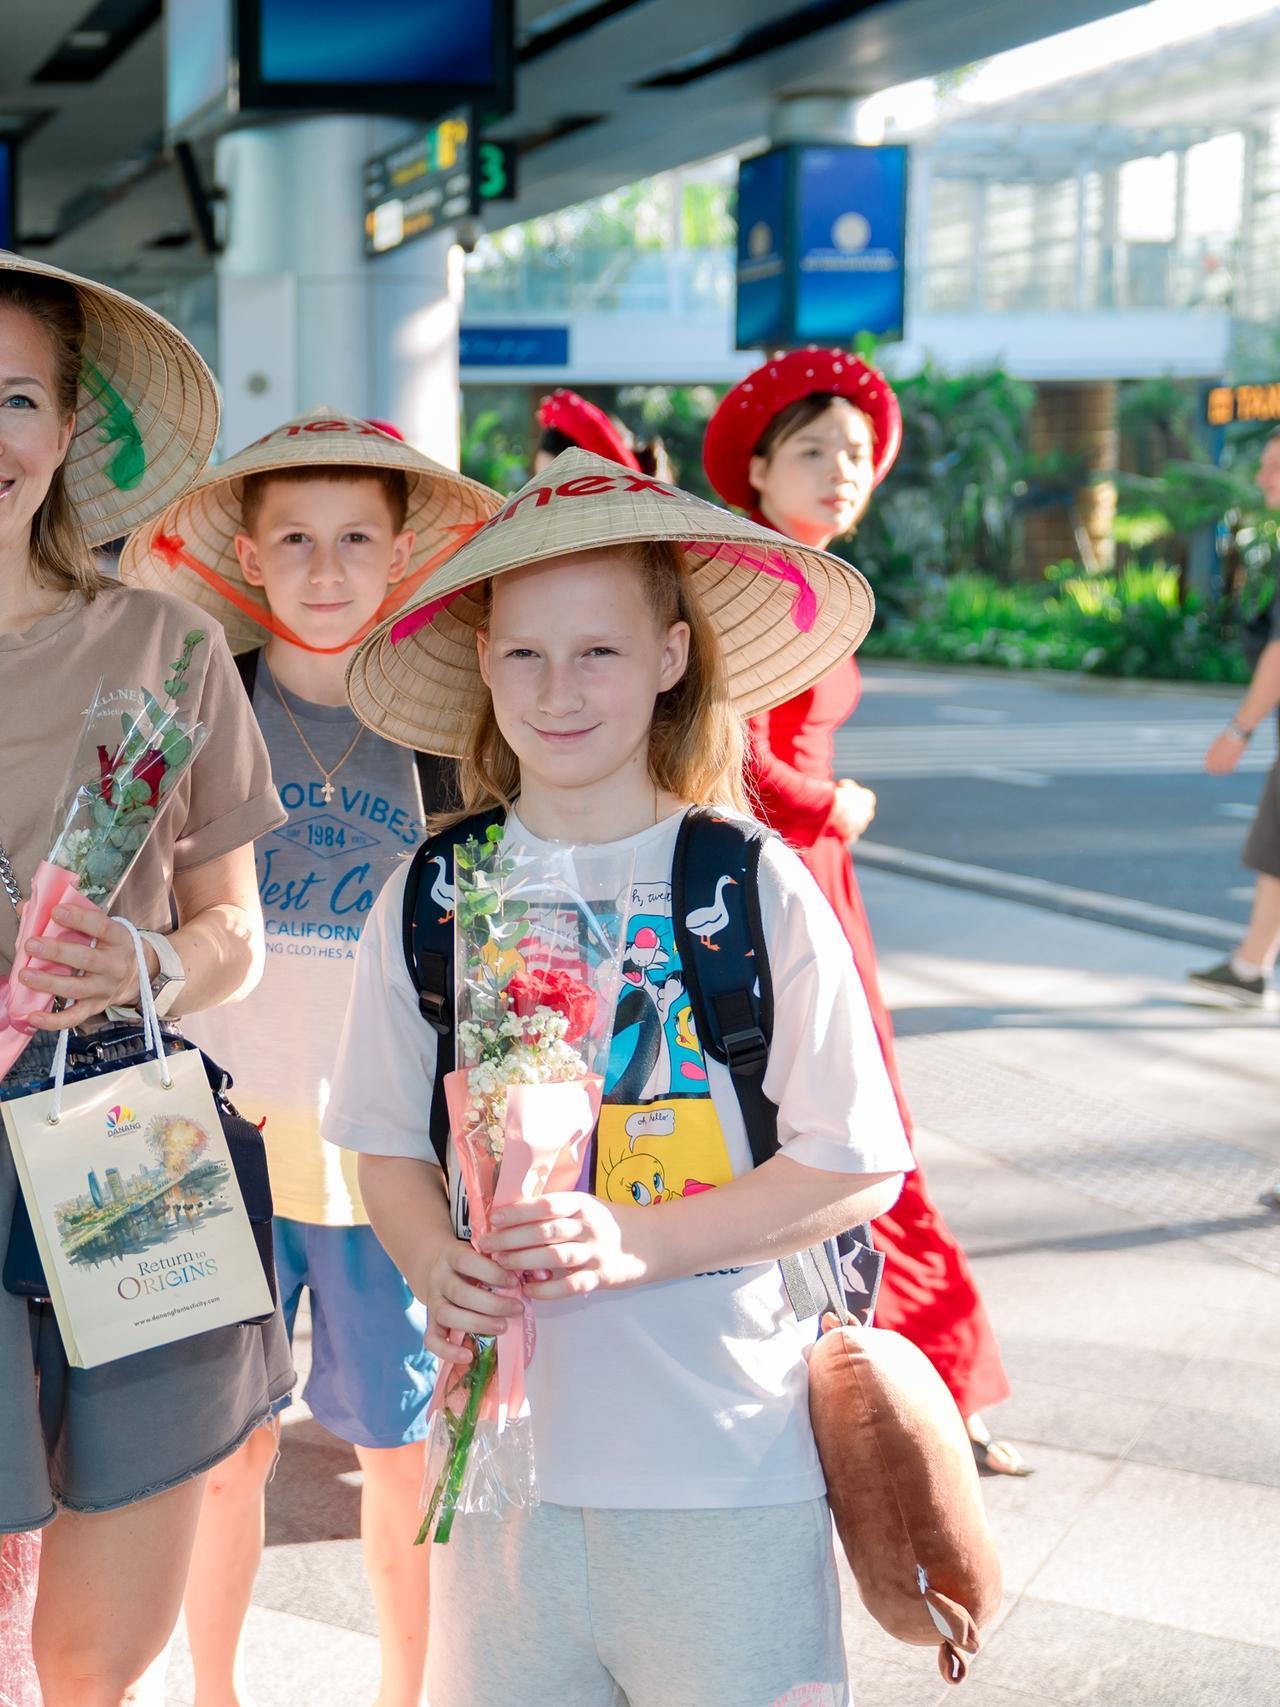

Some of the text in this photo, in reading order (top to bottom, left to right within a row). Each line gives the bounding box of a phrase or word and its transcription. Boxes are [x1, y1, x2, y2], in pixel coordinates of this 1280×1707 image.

[258, 420, 392, 444] nex
[488, 475, 677, 528] nex
[280, 782, 420, 845] OD VIBES
[307, 824, 346, 848] 1984
[265, 919, 362, 942] CALIFORN
[287, 944, 342, 959] CLOTHES
[107, 1122, 141, 1137] DANANG
[138, 1250, 206, 1276] Return to
[117, 1258, 219, 1300] ORIGINS
